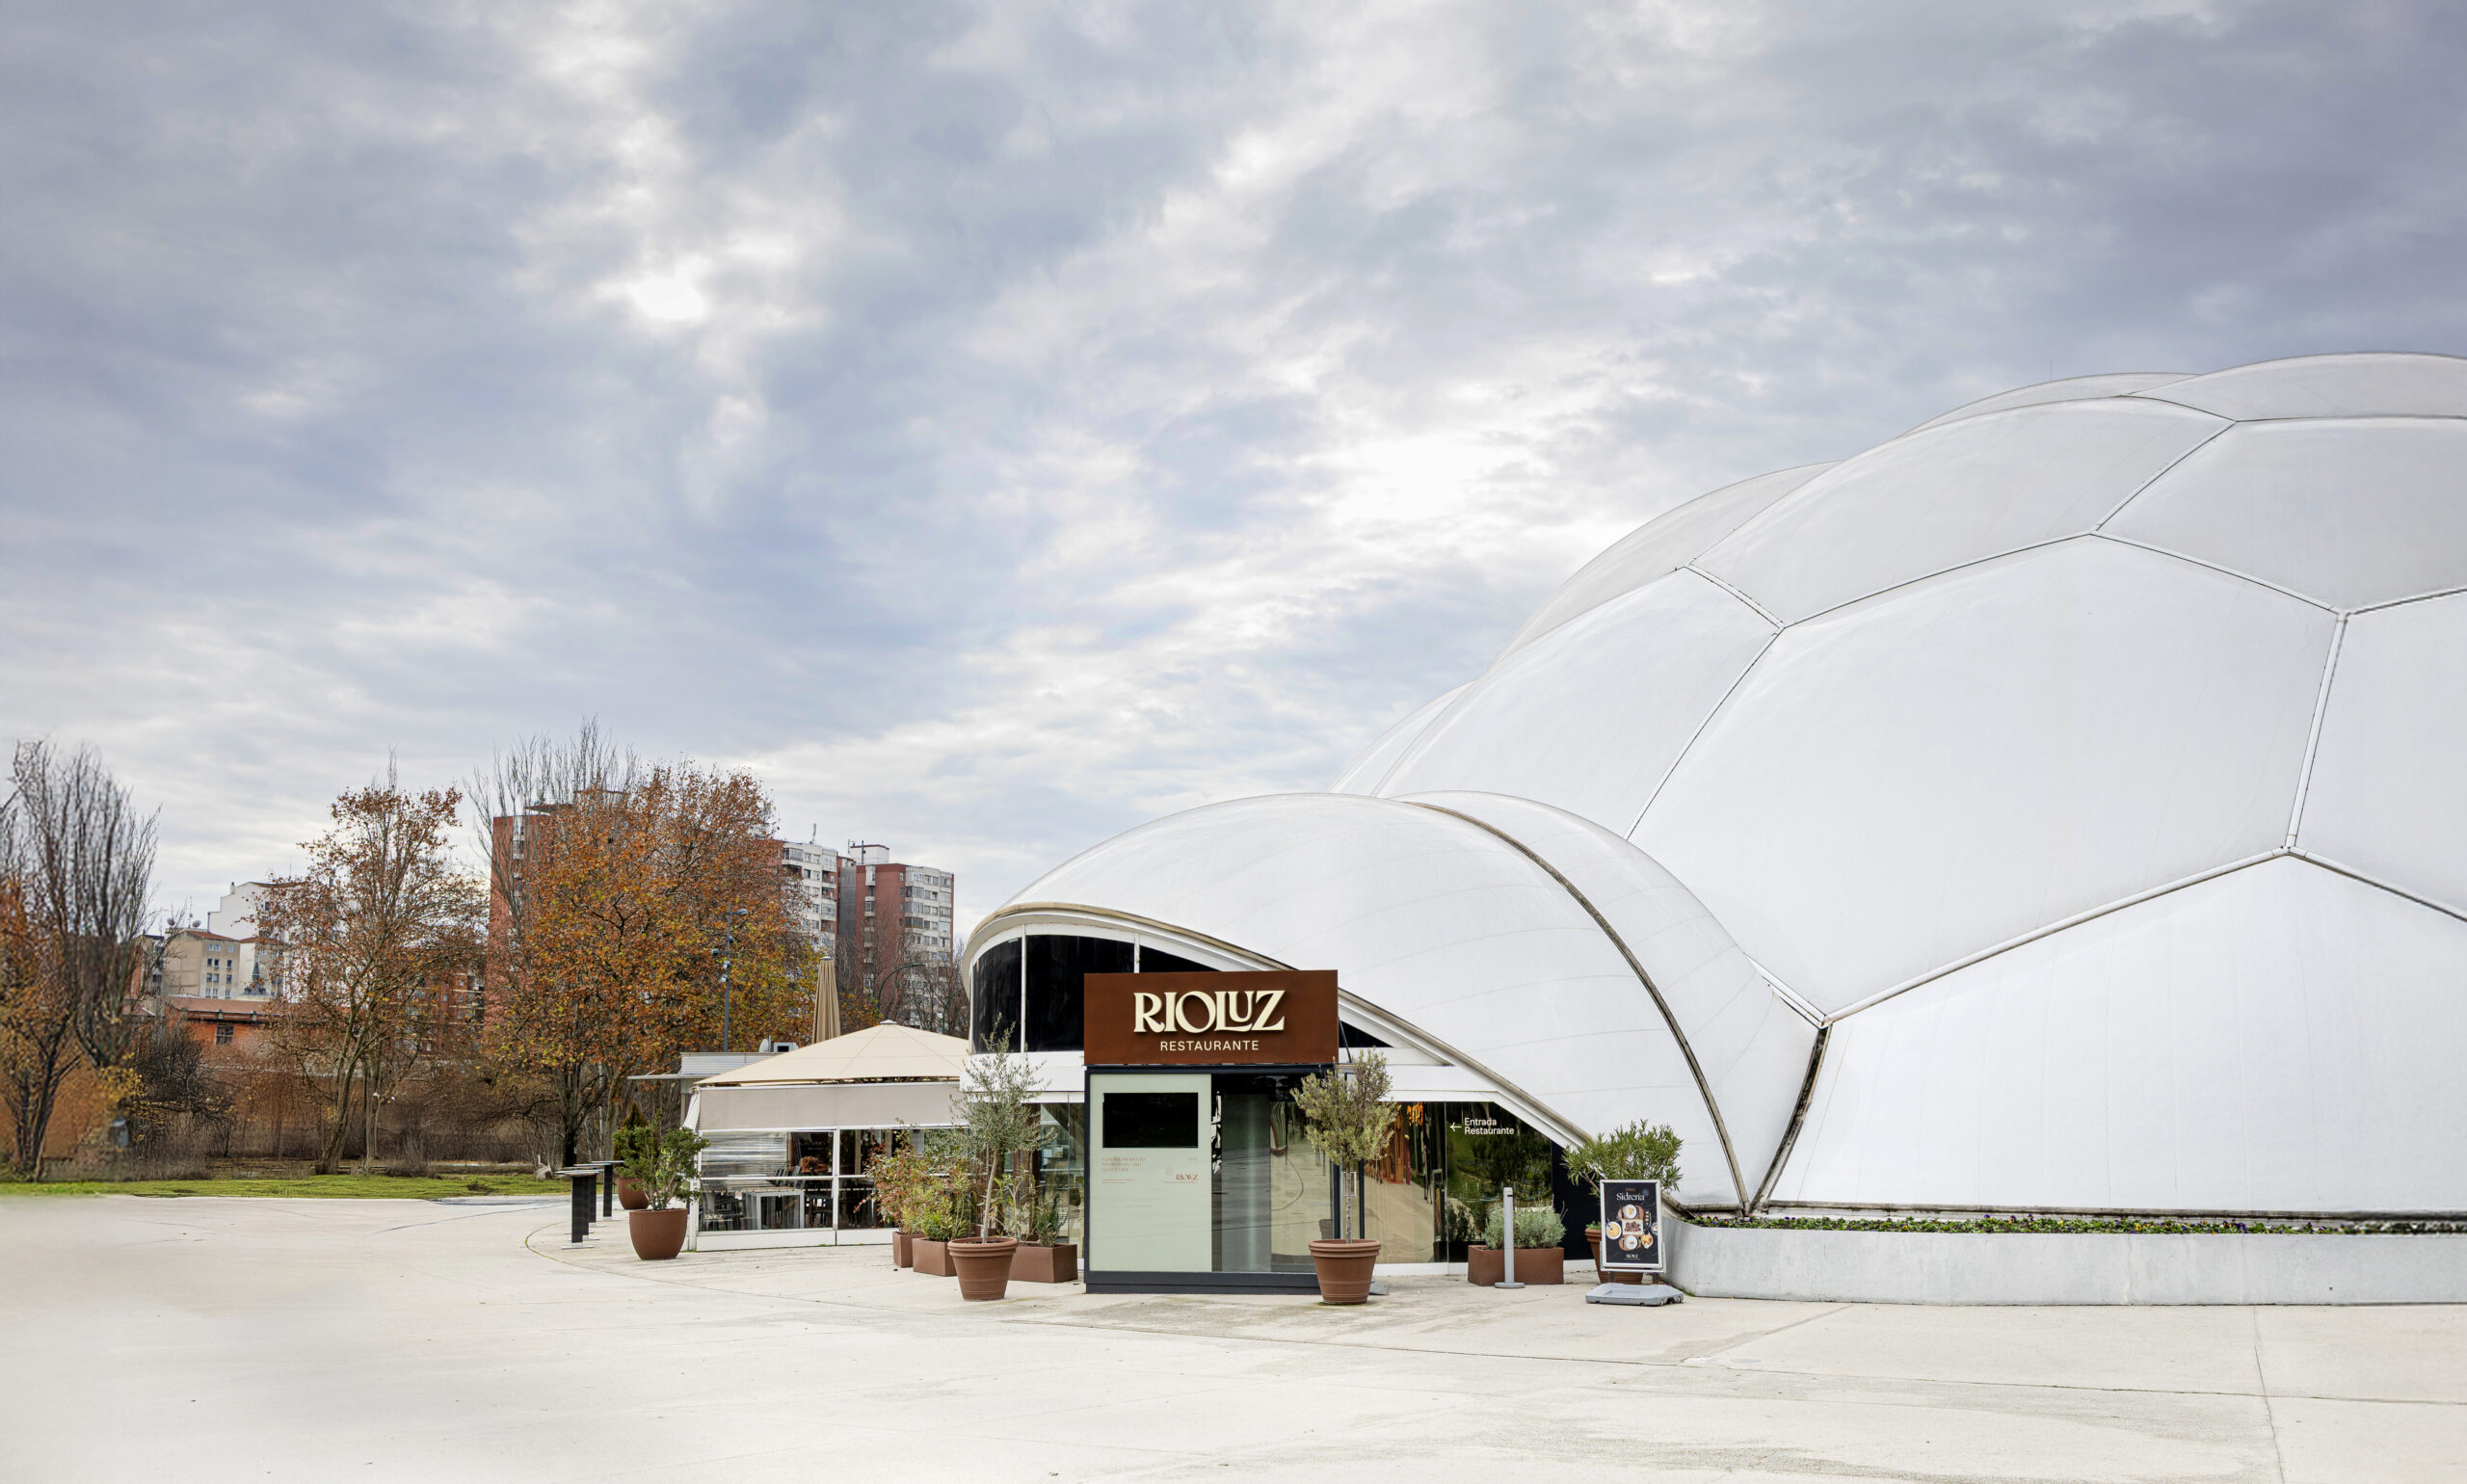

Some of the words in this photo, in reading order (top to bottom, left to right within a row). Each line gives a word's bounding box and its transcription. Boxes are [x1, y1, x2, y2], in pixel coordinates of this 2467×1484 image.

[1133, 991, 1286, 1033] RIOLUZ
[1160, 1041, 1260, 1051] RESTAURANTE
[1464, 1118, 1498, 1126] Entrada
[1464, 1126, 1515, 1135] Restaurante
